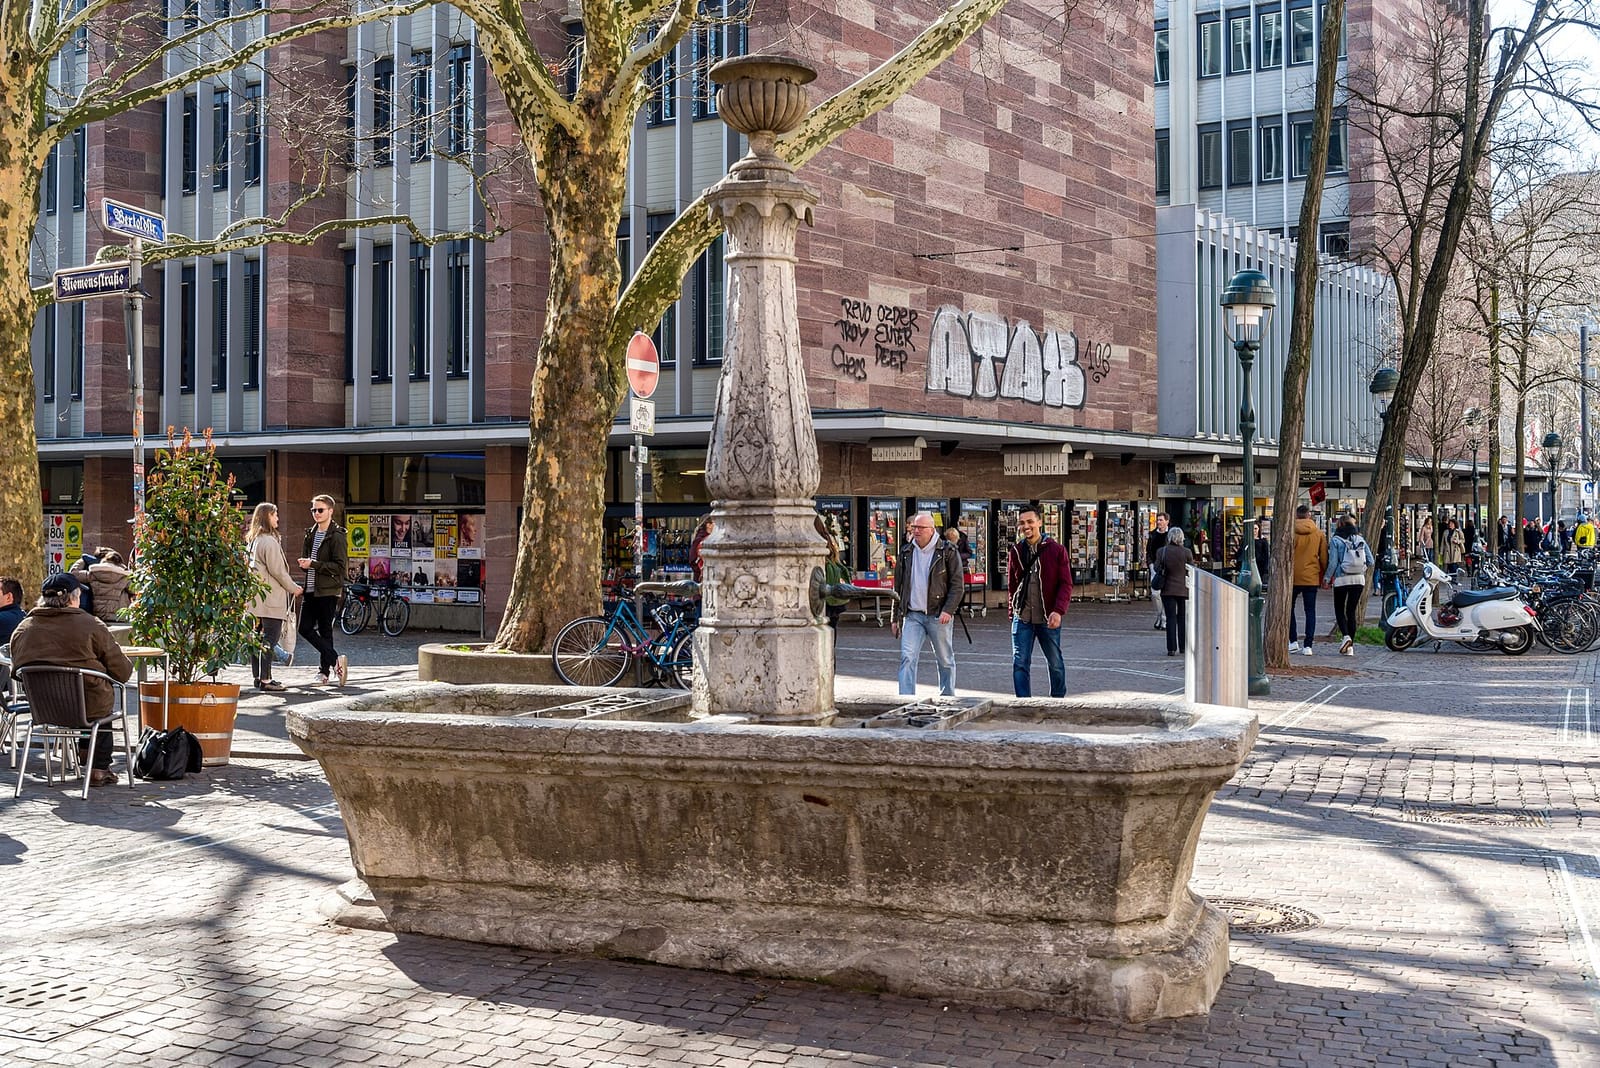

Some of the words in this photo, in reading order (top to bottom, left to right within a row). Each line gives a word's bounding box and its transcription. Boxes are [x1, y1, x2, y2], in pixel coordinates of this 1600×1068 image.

[113, 207, 158, 236] Bertoldstr.
[61, 271, 124, 292] Niemensstraße
[875, 343, 908, 373] DEEP
[1004, 462, 1065, 473] walthari
[50, 527, 64, 539] 80s
